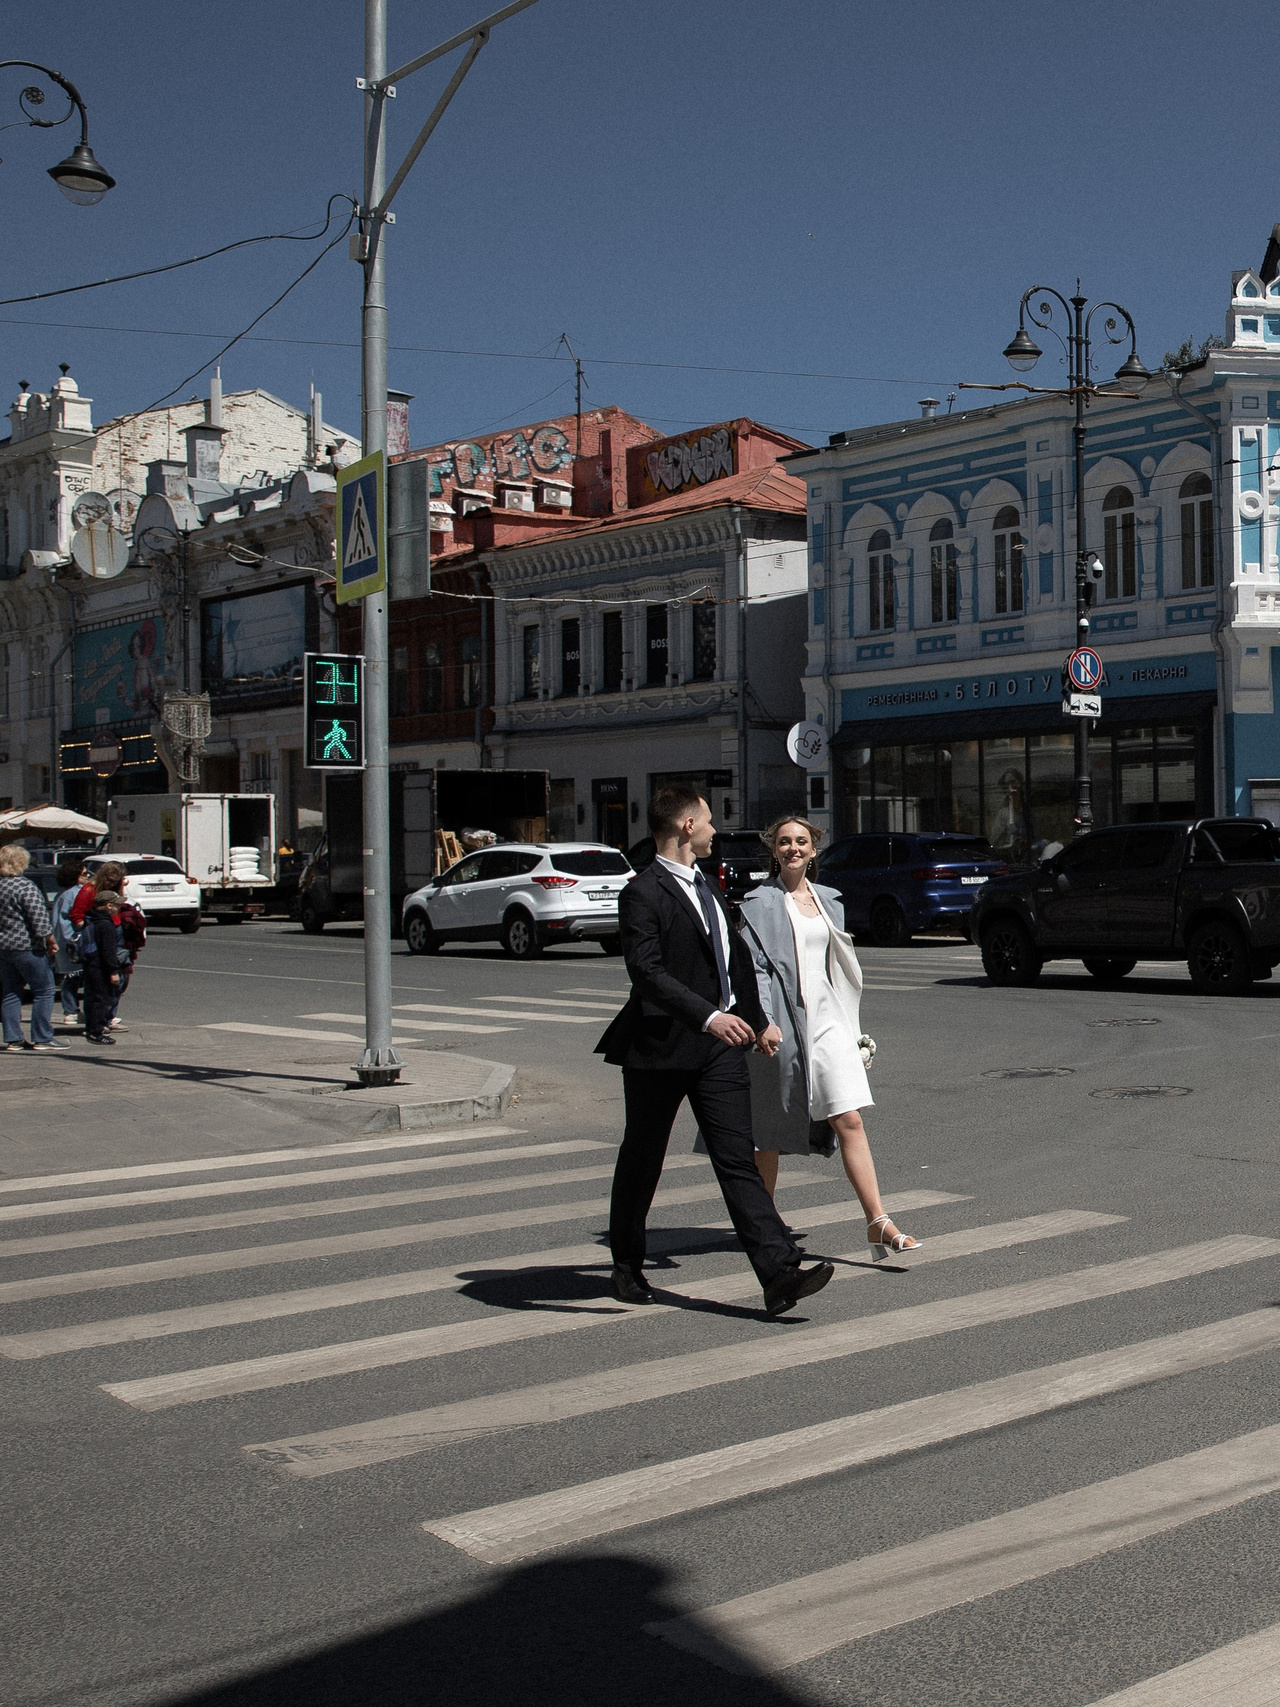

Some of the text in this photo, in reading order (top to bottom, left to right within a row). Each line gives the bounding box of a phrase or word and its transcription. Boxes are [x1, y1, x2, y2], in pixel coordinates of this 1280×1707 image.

[566, 650, 580, 661] BOS
[315, 661, 358, 704] 34
[867, 665, 1187, 707] РЕМЕСЛЕННАЯ БЕЛОТУА ПЕКАРНЯ
[600, 783, 618, 793] BOSS
